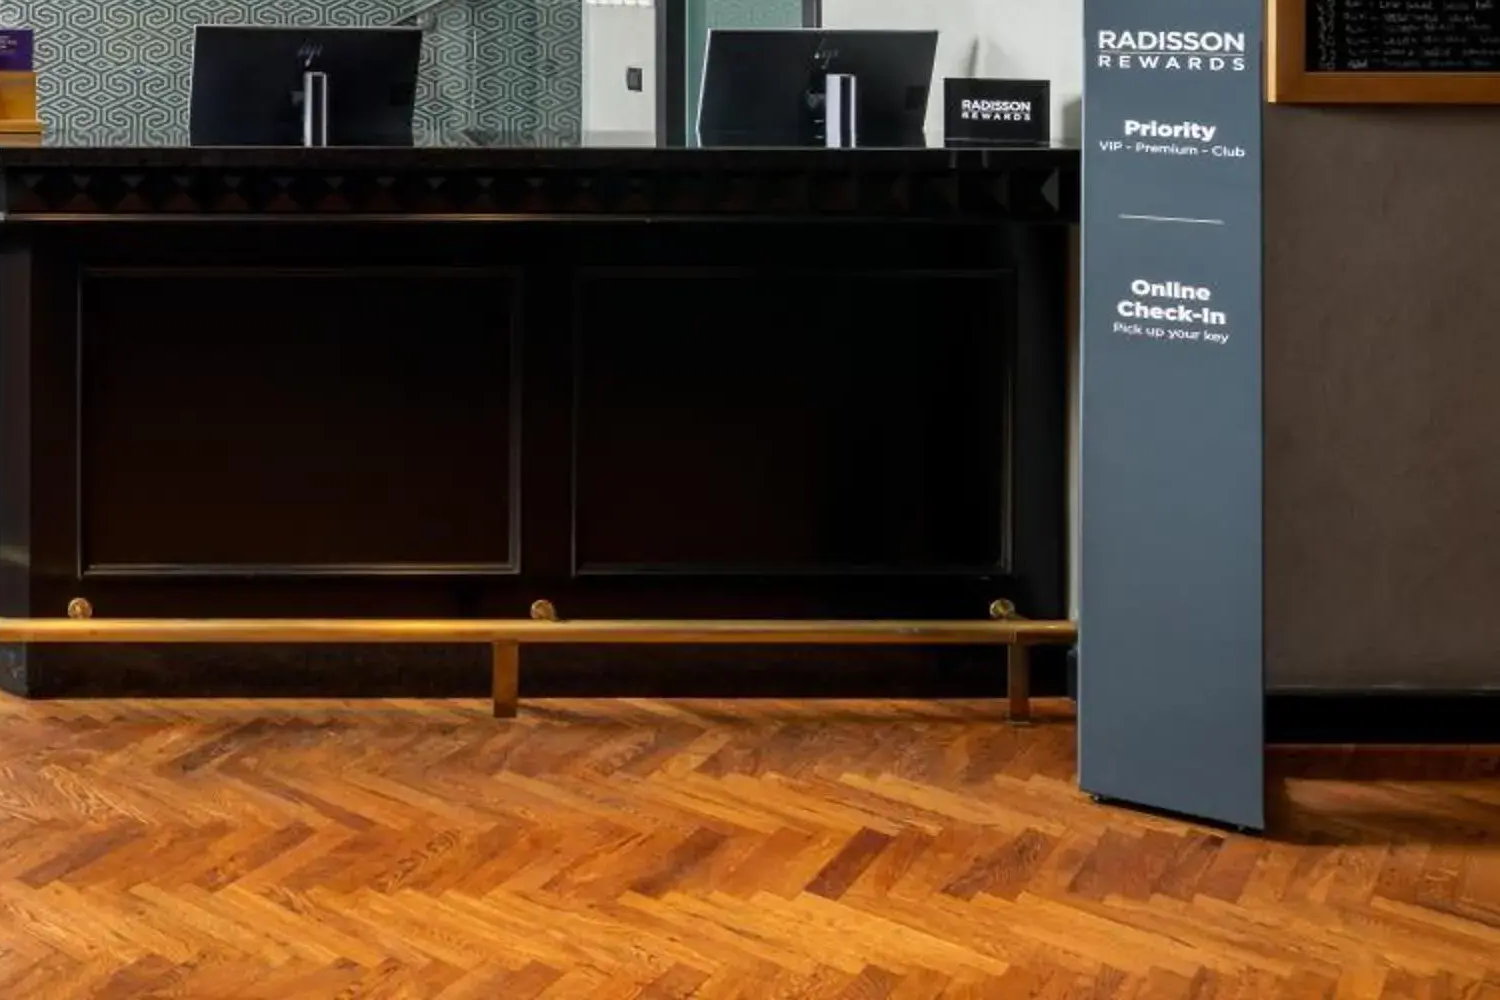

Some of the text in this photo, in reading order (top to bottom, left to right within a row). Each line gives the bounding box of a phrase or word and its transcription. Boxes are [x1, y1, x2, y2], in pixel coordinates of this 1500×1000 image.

[1098, 30, 1245, 51] RADISSON
[1098, 55, 1245, 71] REWARDS
[961, 99, 1031, 112] RADISSON
[961, 112, 1031, 121] REWARDS
[1124, 120, 1216, 142] Priority
[1099, 141, 1122, 151] VIP
[1136, 142, 1198, 156] Premium
[1211, 145, 1245, 157] Club
[1131, 279, 1211, 301] Online
[1113, 322, 1230, 345] Pick up your key
